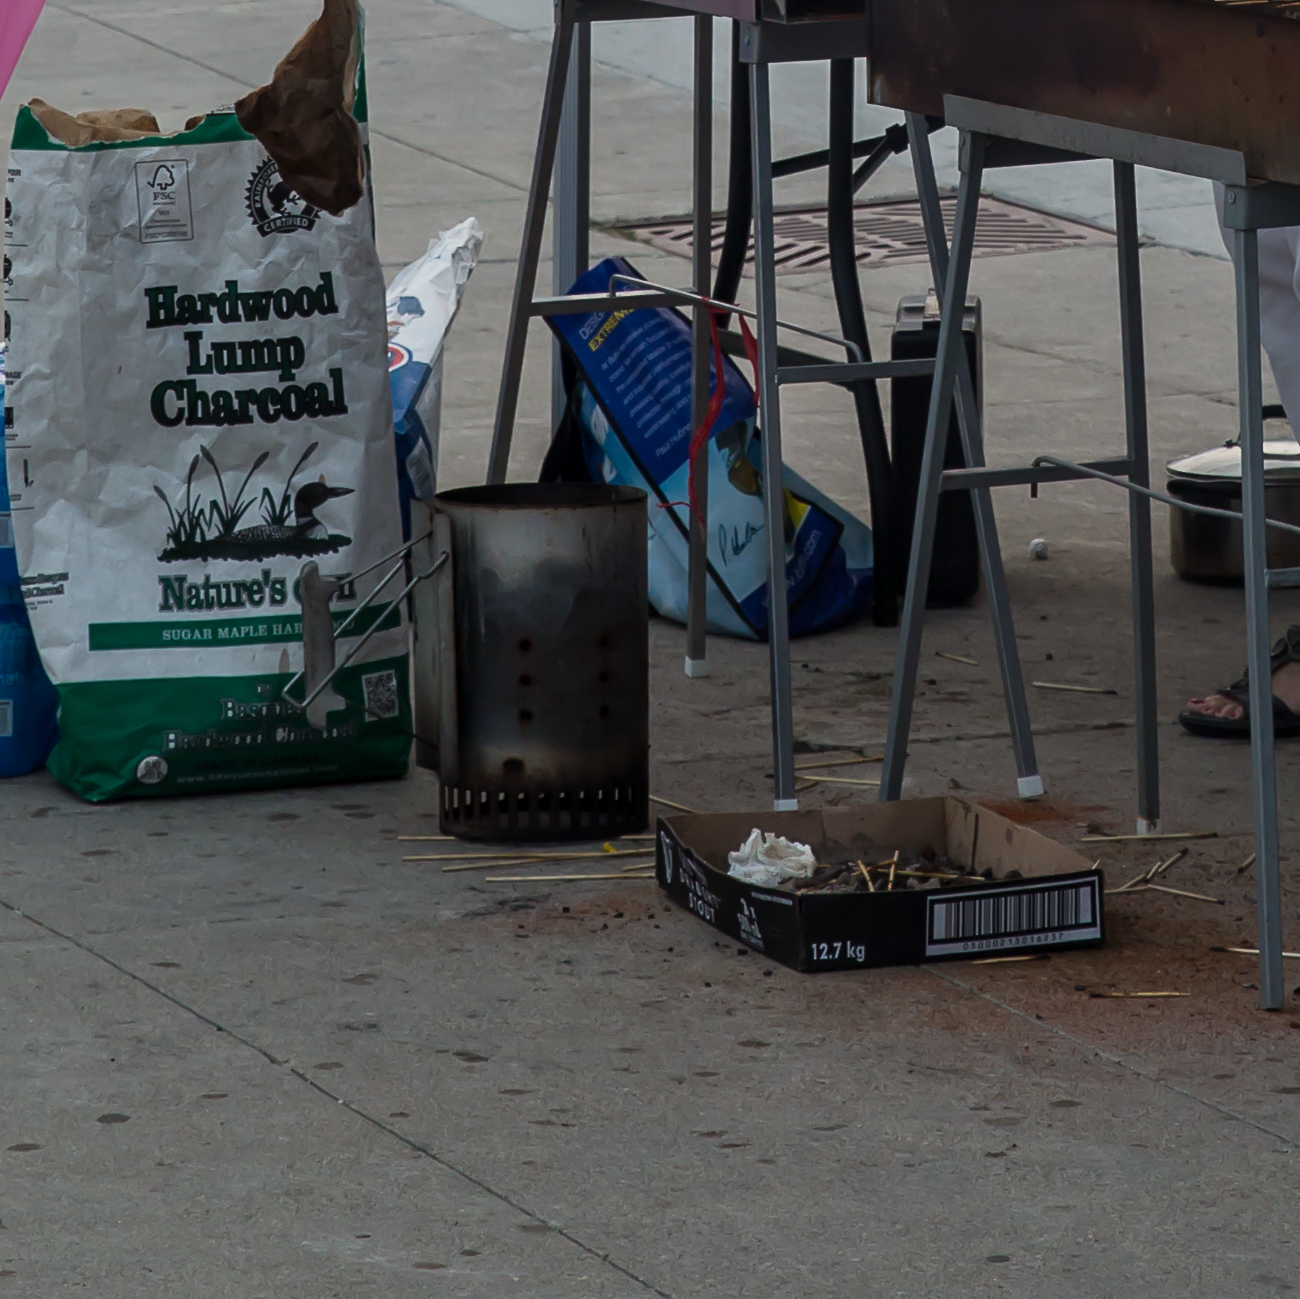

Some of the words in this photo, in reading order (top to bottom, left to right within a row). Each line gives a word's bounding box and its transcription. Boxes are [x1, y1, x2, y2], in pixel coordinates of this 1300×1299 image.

[263, 219, 309, 233] CERTIFIED
[144, 271, 339, 329] Hardwood
[183, 330, 305, 383] Lump
[150, 367, 348, 428] Charcoal
[158, 568, 287, 613] Nature's
[162, 628, 213, 641] SUGAR
[217, 624, 268, 640] MAPLE
[811, 942, 842, 961] 12.7
[846, 941, 866, 962] kg
